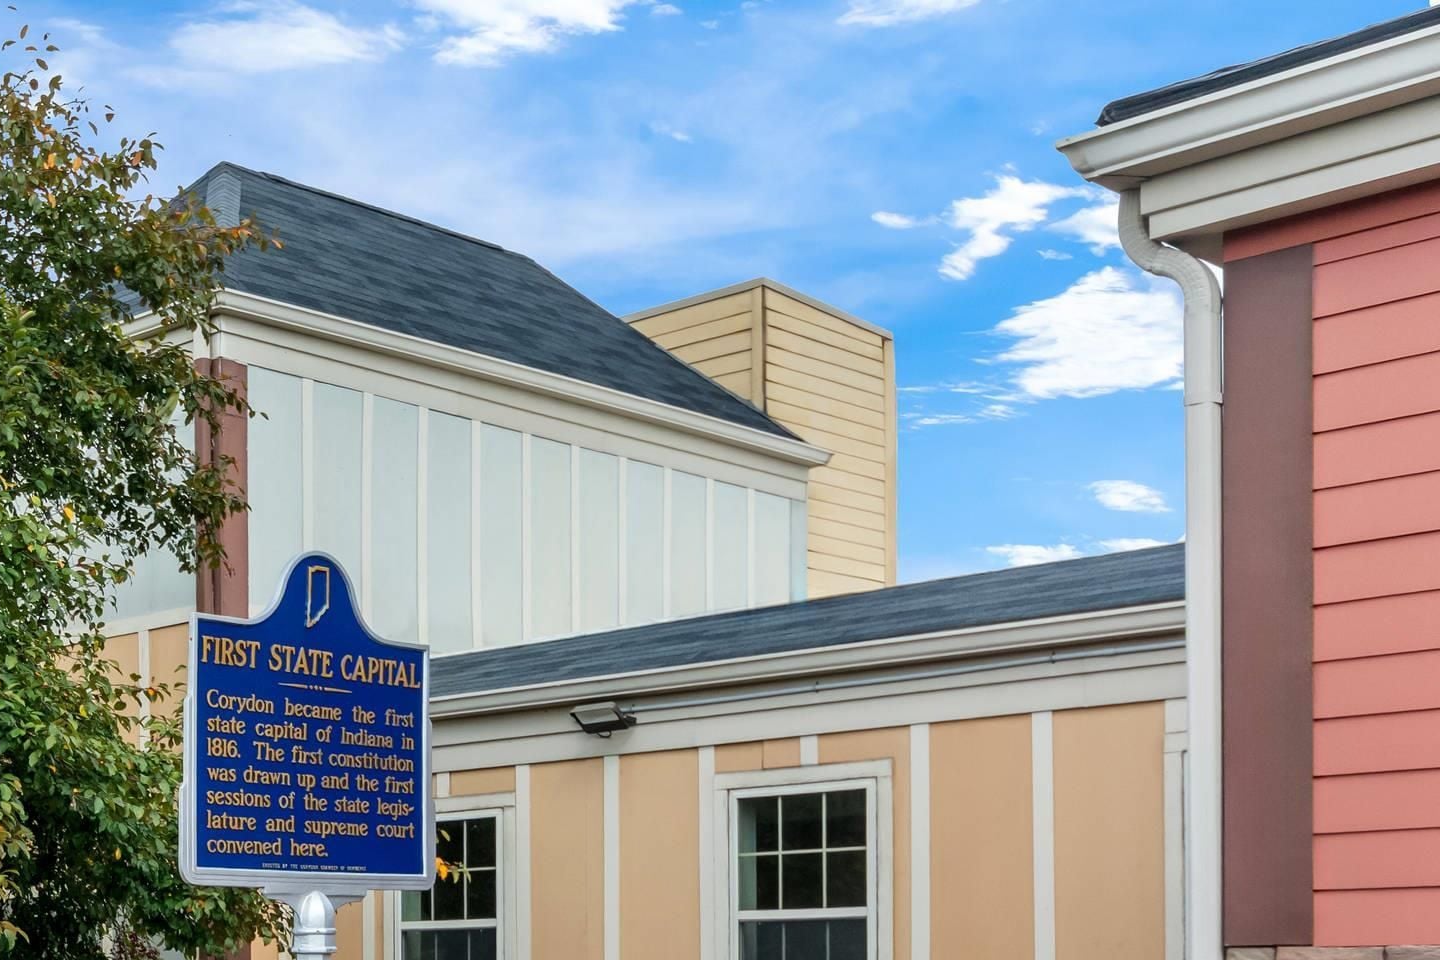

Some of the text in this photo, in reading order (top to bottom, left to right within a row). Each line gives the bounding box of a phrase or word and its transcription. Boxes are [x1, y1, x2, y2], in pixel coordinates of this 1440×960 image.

[201, 635, 421, 688] FIRST STATE CAPITAL
[207, 689, 414, 728] Corydon became the first
[207, 716, 414, 750] state capital of Indiana in
[207, 737, 414, 772] 1816. The first constitution
[207, 767, 414, 794] was drawn up and the first
[207, 789, 414, 820] sessions of the state legis-
[207, 810, 414, 839] lature and supreme court
[207, 838, 328, 857] convened here.
